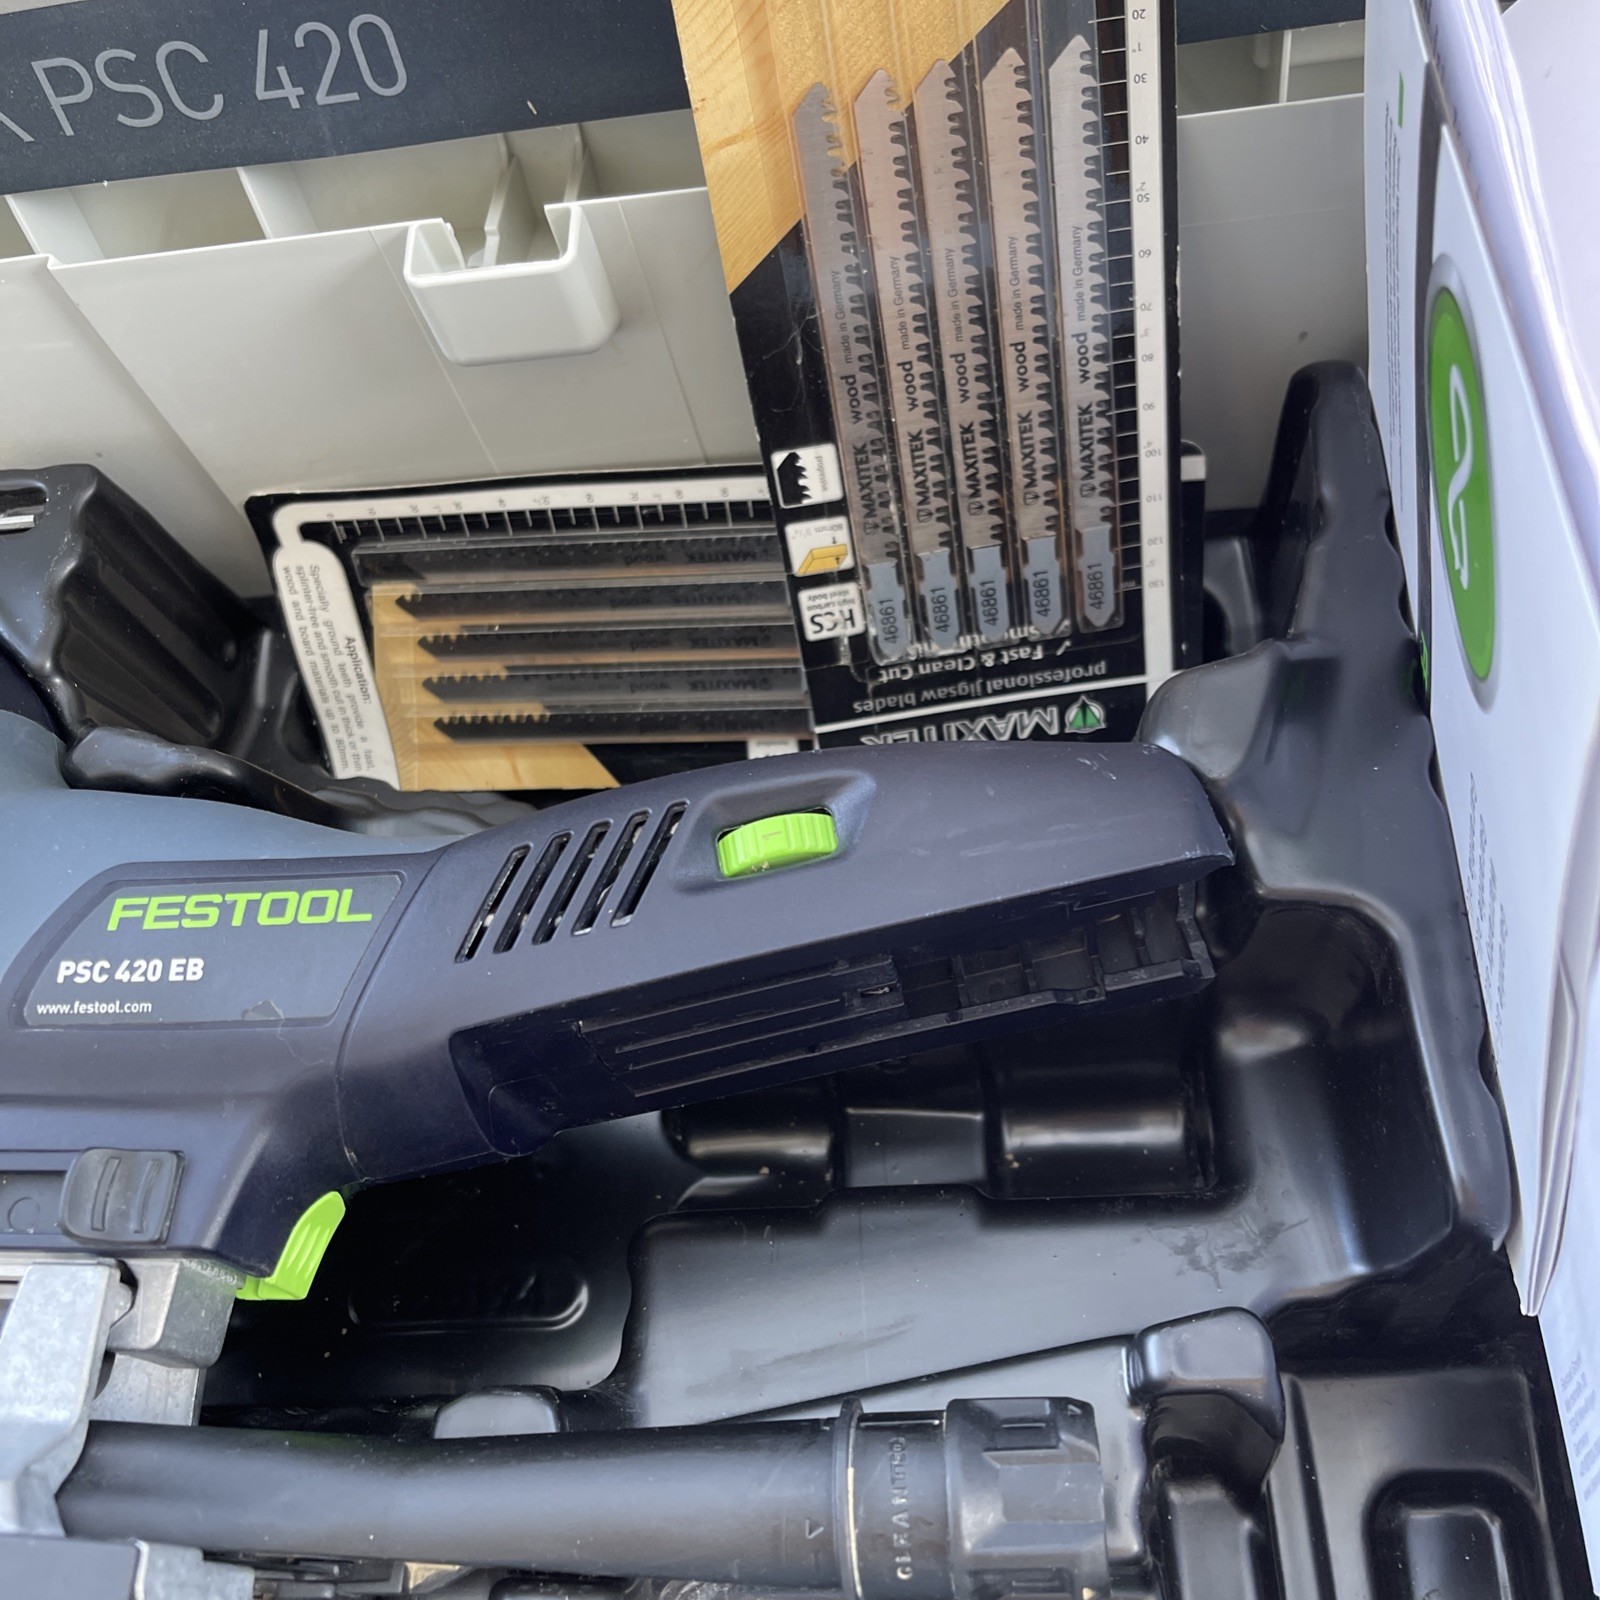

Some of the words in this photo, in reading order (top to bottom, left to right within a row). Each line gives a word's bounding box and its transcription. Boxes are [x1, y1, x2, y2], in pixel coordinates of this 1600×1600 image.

[1132, 9, 1146, 20] 20
[31, 40, 225, 136] PSC
[255, 13, 408, 109] 420
[1133, 73, 1147, 84] 30
[1135, 135, 1149, 145] 40
[1136, 193, 1150, 203] 50
[1008, 236, 1020, 287] Germany
[1072, 225, 1084, 276] Germany
[1138, 249, 1151, 259] 60
[890, 256, 904, 306] Germany
[944, 247, 958, 297] Germany
[1075, 279, 1084, 290] in
[831, 270, 845, 320] Germany
[950, 300, 960, 310] in
[1012, 289, 1021, 300] in
[1075, 290, 1087, 321] made
[1140, 303, 1152, 312] 70
[839, 322, 847, 333] in
[897, 308, 905, 319] in
[951, 313, 963, 342] made
[1013, 301, 1024, 330] made
[841, 334, 853, 364] made
[898, 321, 910, 350] made
[1009, 341, 1030, 392] wood
[1071, 332, 1091, 384] wood
[1141, 354, 1154, 363] 80
[897, 361, 919, 412] wood
[949, 353, 970, 404] wood
[840, 375, 863, 425] wood
[1142, 403, 1155, 411] 90
[1017, 410, 1038, 490] MAXITEK
[1076, 401, 1095, 481] MAXITEK
[1145, 449, 1162, 458] 100
[907, 429, 931, 506] MAXITEK
[959, 421, 981, 499] MAXITEK
[853, 441, 877, 519] MAXITEK
[1033, 570, 1051, 617] 46861
[1087, 562, 1105, 609] 46861
[930, 586, 951, 633] 46861
[979, 579, 999, 626] 46861
[283, 565, 299, 595] wood
[291, 600, 306, 621] and
[299, 626, 316, 656] board
[309, 660, 330, 704] materials
[295, 565, 320, 628] splinter-free
[314, 630, 328, 650] and
[321, 652, 339, 688] smooth
[810, 609, 855, 634] HCS
[879, 598, 899, 644] 46861
[310, 564, 330, 613] Specially
[323, 620, 344, 656] ground
[338, 661, 352, 688] teeth
[345, 693, 364, 729] provide
[980, 653, 997, 667] &
[1000, 644, 1043, 665] Fast
[345, 635, 372, 704] Application:
[879, 668, 914, 683] Cut
[920, 657, 975, 676] Clean
[986, 661, 1107, 688] professional
[853, 692, 916, 713] blades
[920, 678, 983, 702] jigsaw
[107, 888, 373, 932] FESTOOL
[57, 960, 111, 983] PSC
[114, 958, 163, 982] 420
[168, 957, 205, 982] EB
[37, 1000, 152, 1015] www.festool.com
